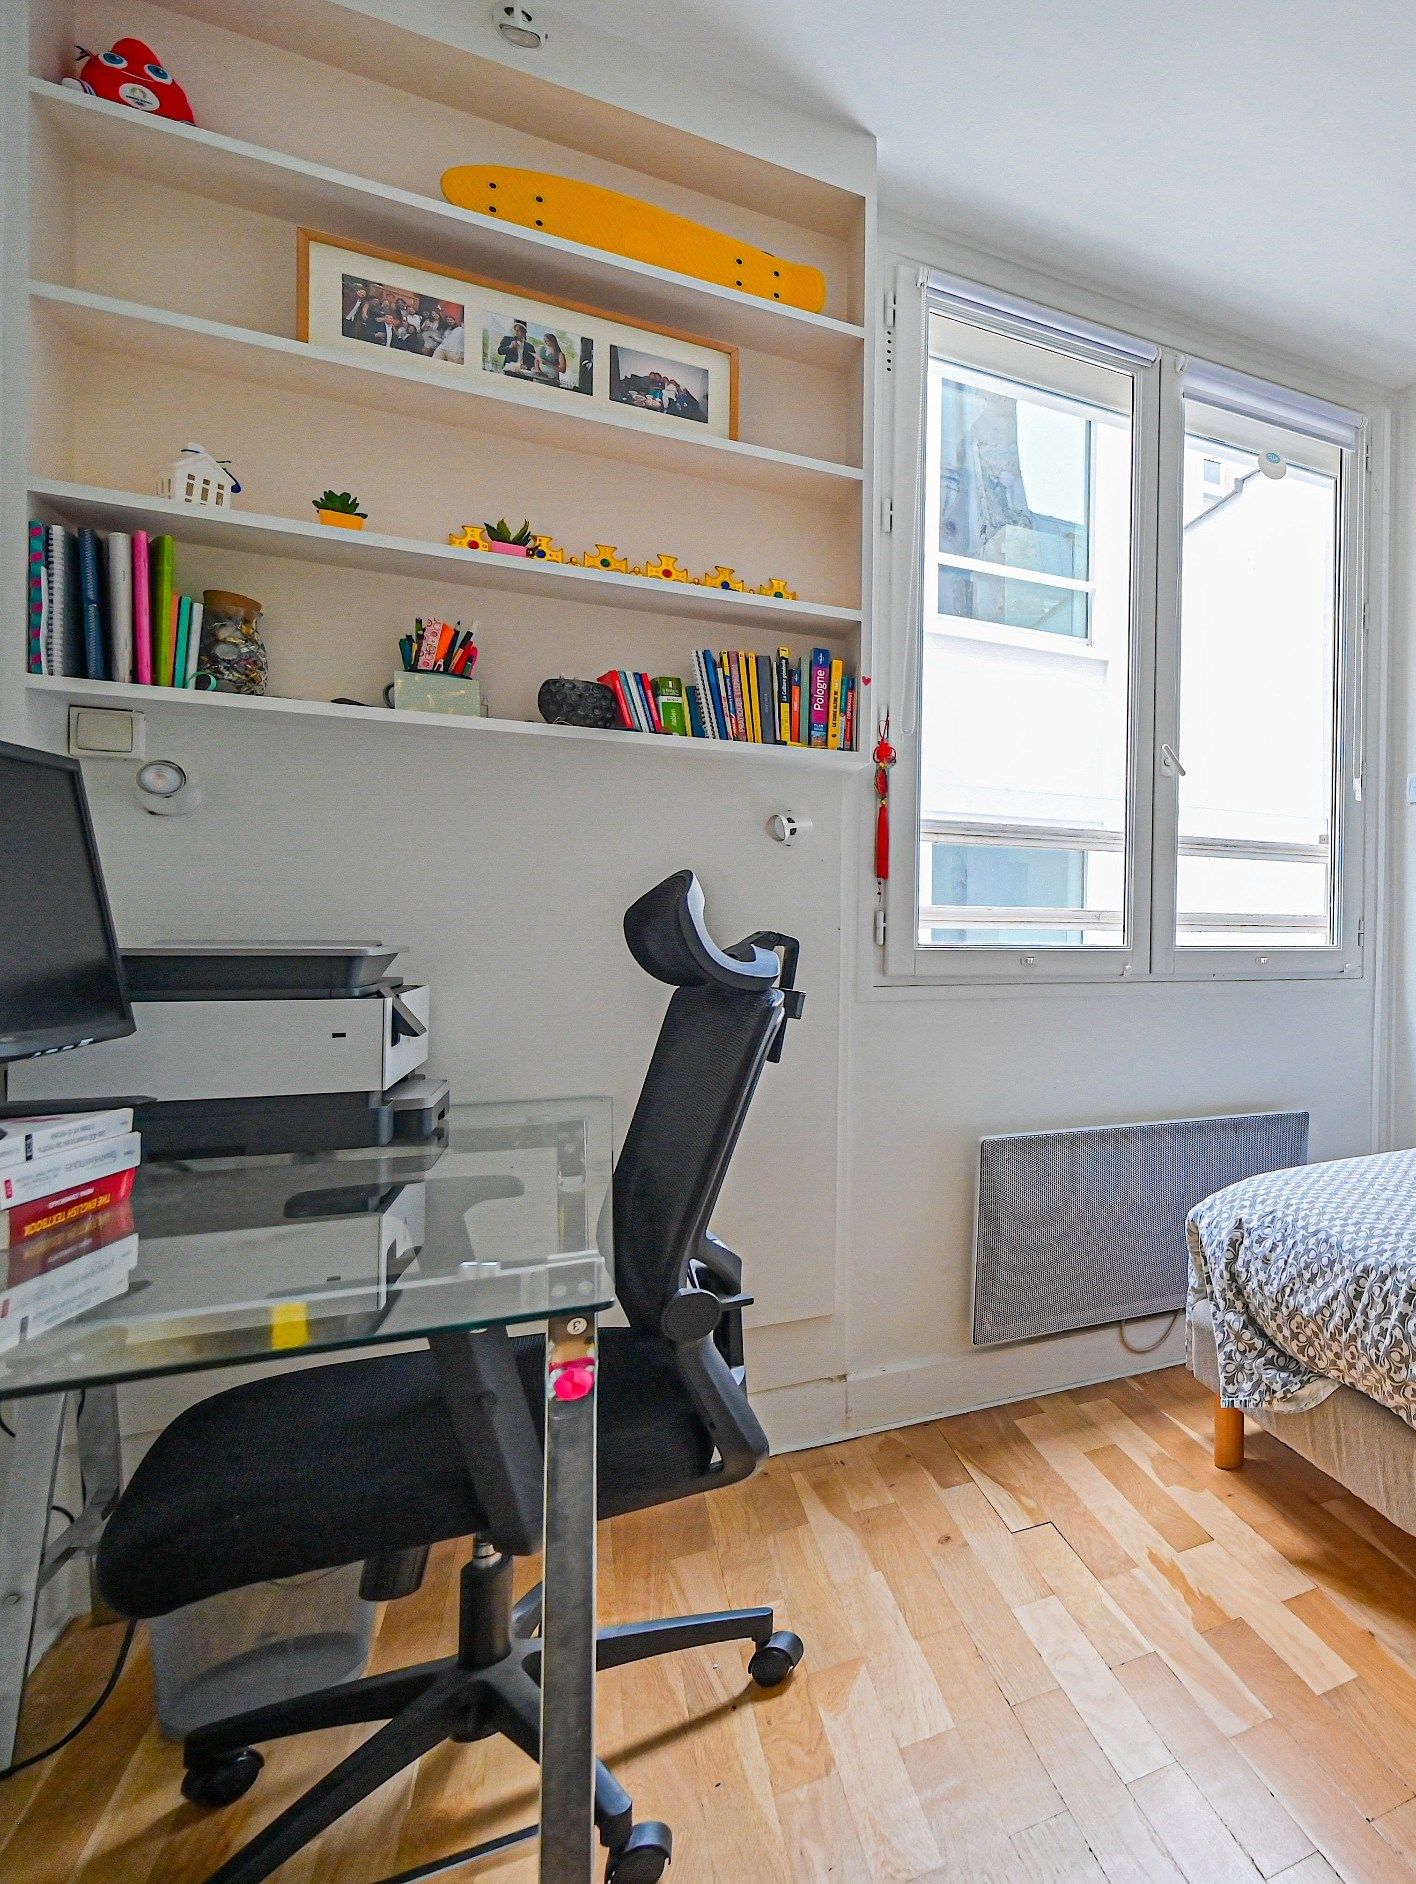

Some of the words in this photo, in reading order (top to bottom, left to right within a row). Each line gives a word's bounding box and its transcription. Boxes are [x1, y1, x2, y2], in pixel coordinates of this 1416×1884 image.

[813, 669, 828, 711] Pologne
[67, 1199, 98, 1219] ENGLISH
[98, 1192, 111, 1207] THE
[23, 1210, 66, 1237] TEXTBOOK
